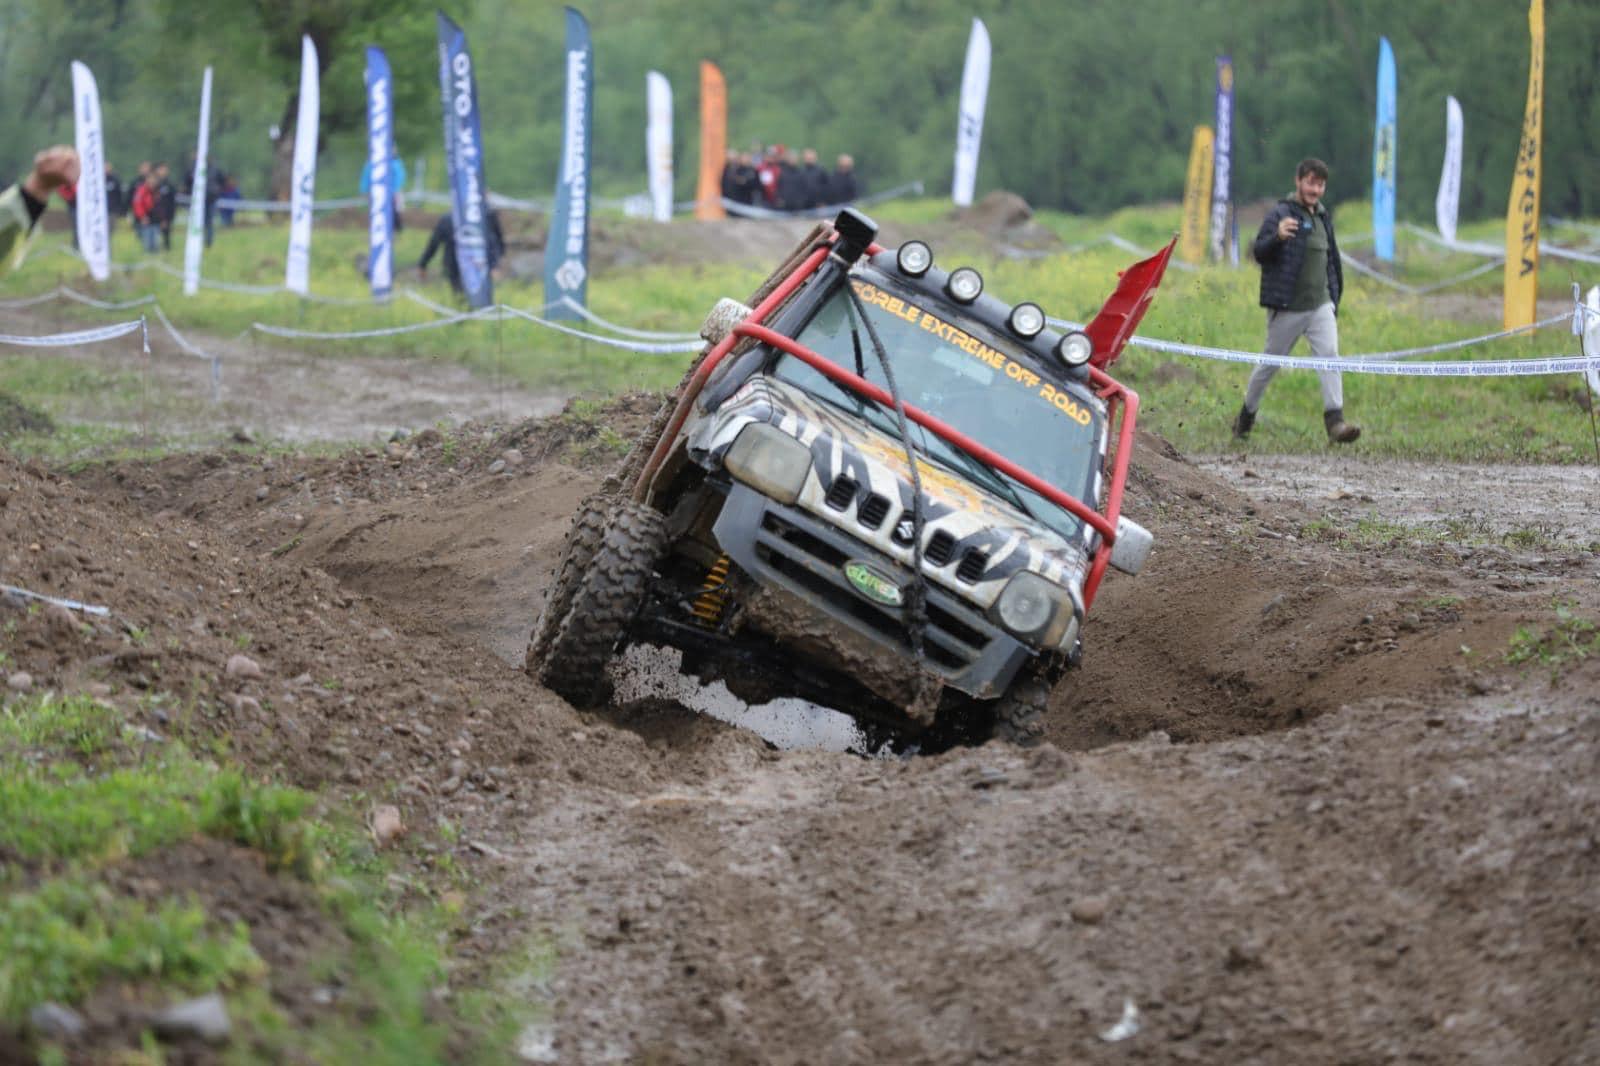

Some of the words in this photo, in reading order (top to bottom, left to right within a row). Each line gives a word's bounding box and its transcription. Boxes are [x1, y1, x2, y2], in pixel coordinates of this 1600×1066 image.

[452, 53, 472, 117] OTO
[919, 313, 1007, 370] EXTREME
[1005, 361, 1041, 388] OFF
[1038, 383, 1092, 426] ROAD
